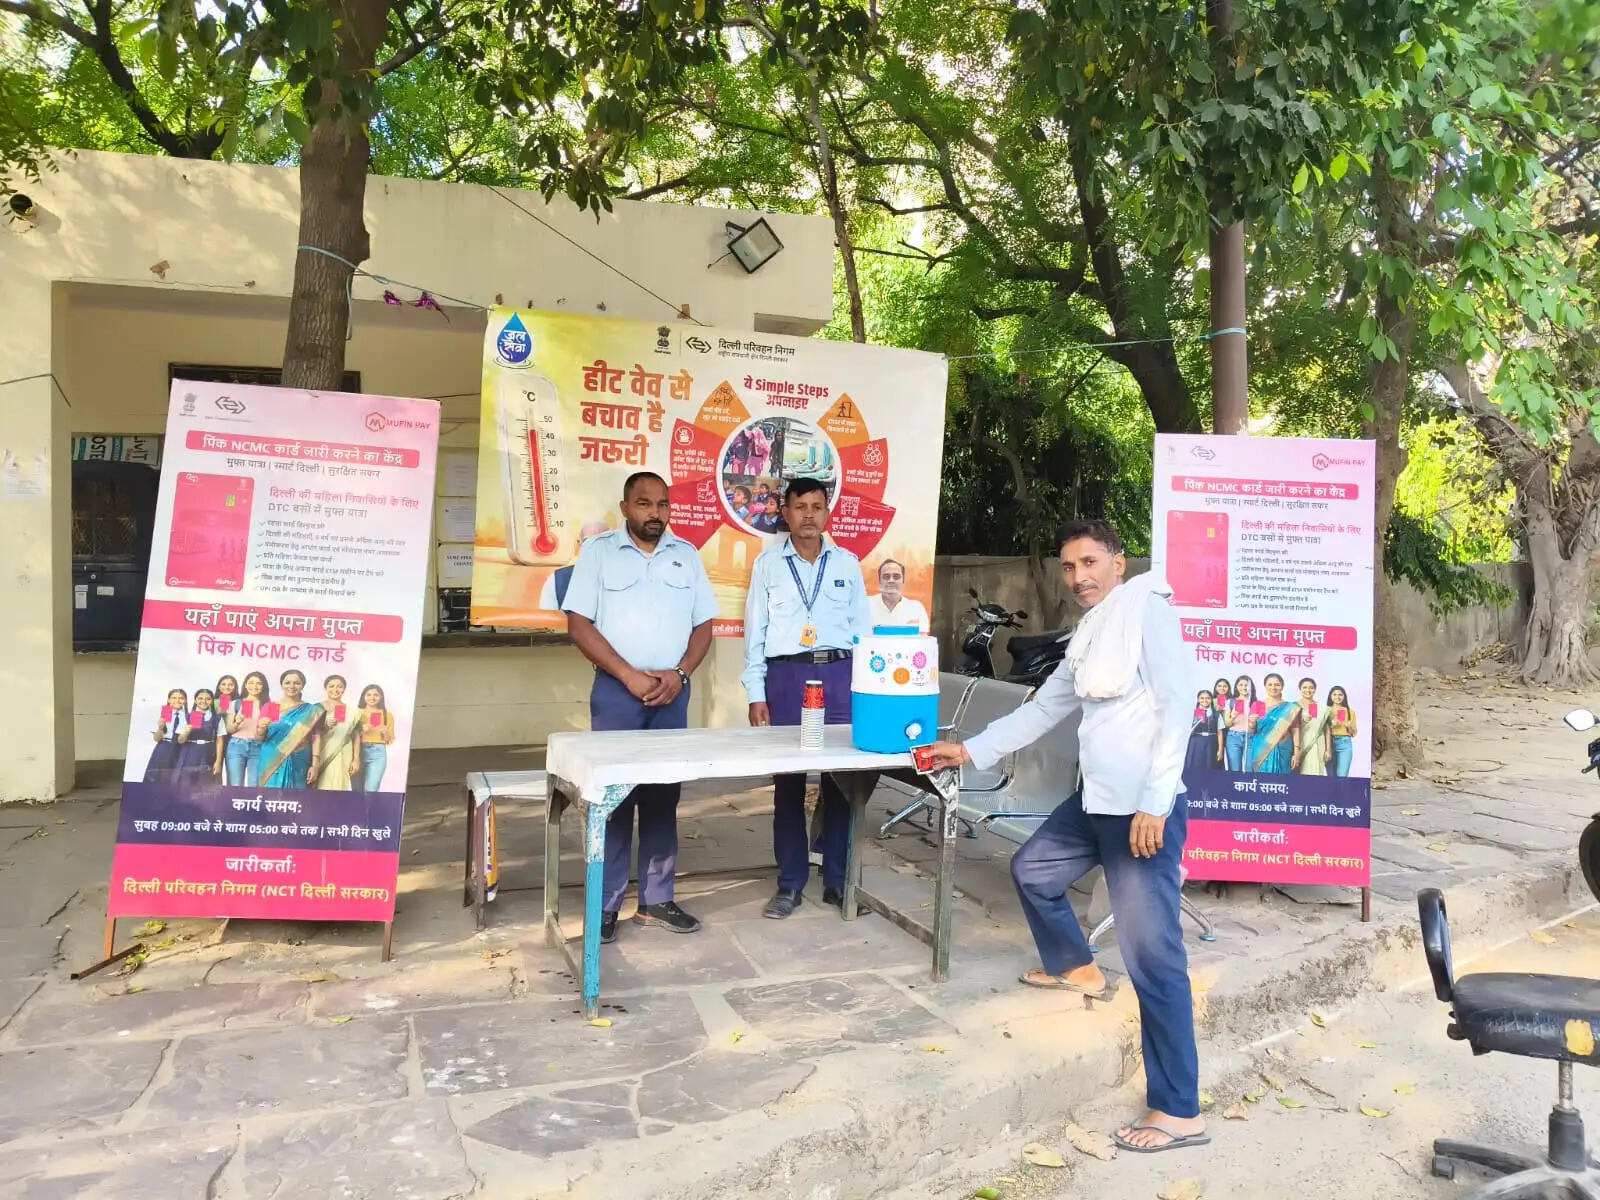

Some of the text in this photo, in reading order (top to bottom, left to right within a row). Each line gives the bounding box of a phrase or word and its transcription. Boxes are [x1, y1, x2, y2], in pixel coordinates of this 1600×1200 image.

[502, 338, 526, 353] सेवा
[504, 329, 527, 343] जल
[718, 338, 795, 356] दिल्ली परिवहन निगम
[582, 360, 694, 401] हीट वेव से
[743, 375, 829, 397] ये Simple Steps
[766, 394, 809, 410] अपनाइए
[580, 400, 666, 432] बचाव है
[203, 434, 402, 464] पिंक NCMC कार्ड जारी करने का केंद्र
[579, 434, 649, 465] जरूरी
[227, 457, 245, 467] मुफ्त
[248, 459, 266, 468] यात्रा
[274, 460, 294, 471] स्मार्ट
[297, 462, 320, 473] दिल्ली
[328, 466, 357, 477] सुरक्षित
[269, 486, 296, 499] दिल्ली
[298, 489, 311, 501] की
[1208, 483, 1238, 492] NCMC
[1241, 481, 1263, 493] कार्ड
[1264, 483, 1285, 495] जारी
[1288, 484, 1311, 496] करने
[1314, 487, 1327, 496] का
[268, 503, 289, 512] DTC
[292, 502, 311, 515] बसों
[324, 506, 345, 518] मुफ्त
[347, 508, 367, 518] यात्रा
[184, 603, 364, 638] यहाँ पाएं अपना मुफ्त
[1184, 619, 1326, 646] यहाँ पाएं अपना मुफ्त
[197, 634, 347, 663] पिंक NCMC कार्ड
[1195, 644, 1314, 668] पिंक NCMC कार्ड
[1233, 779, 1289, 795] कार्य समय:
[232, 795, 302, 814] कार्य समय:
[1205, 799, 1219, 809] बजे
[1221, 798, 1228, 810] से
[1230, 802, 1247, 811] शाम
[1249, 803, 1272, 812] 05:00
[1274, 802, 1287, 813] बजे
[1289, 804, 1303, 813] तक
[1310, 804, 1327, 815] सभी
[1329, 805, 1344, 816] दिन
[1345, 806, 1361, 818] खुले
[134, 819, 391, 841] सुबह 09:00 बजे से शाम 05:00 बजे तक सभी दिन खुले
[1233, 828, 1288, 844] जारीकर्ता:
[225, 854, 296, 874] जारीकर्ता:
[1188, 848, 1364, 870] परिवहन निगम (NCT दिल्ली सरकार)
[123, 876, 390, 902] दिल्ली परिवहन निगम (NCT दिल्ली सरकार)
